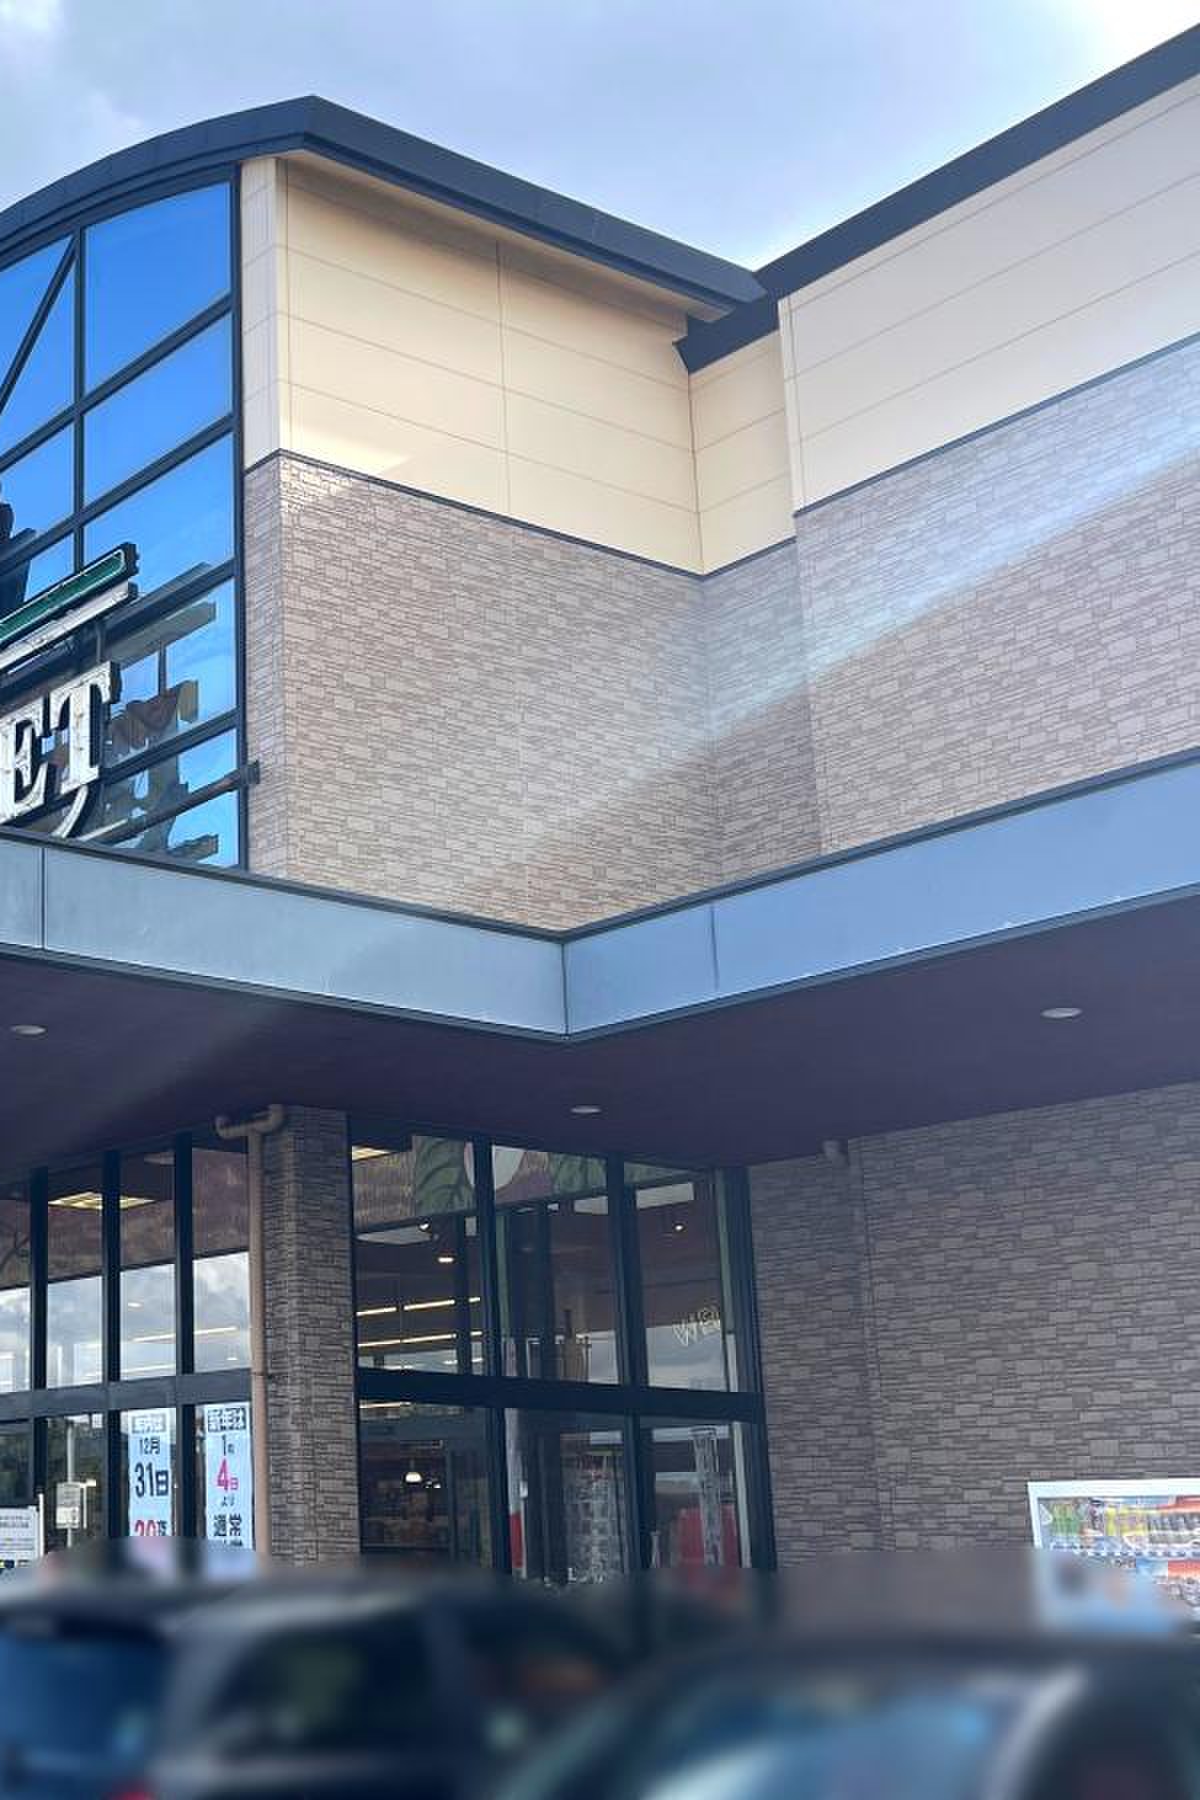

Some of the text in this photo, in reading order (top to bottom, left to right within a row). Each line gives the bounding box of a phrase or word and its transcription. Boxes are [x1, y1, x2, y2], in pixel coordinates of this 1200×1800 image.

[139, 1437, 160, 1454] 12月
[134, 1462, 169, 1497] 31日
[217, 1459, 238, 1490] 4日
